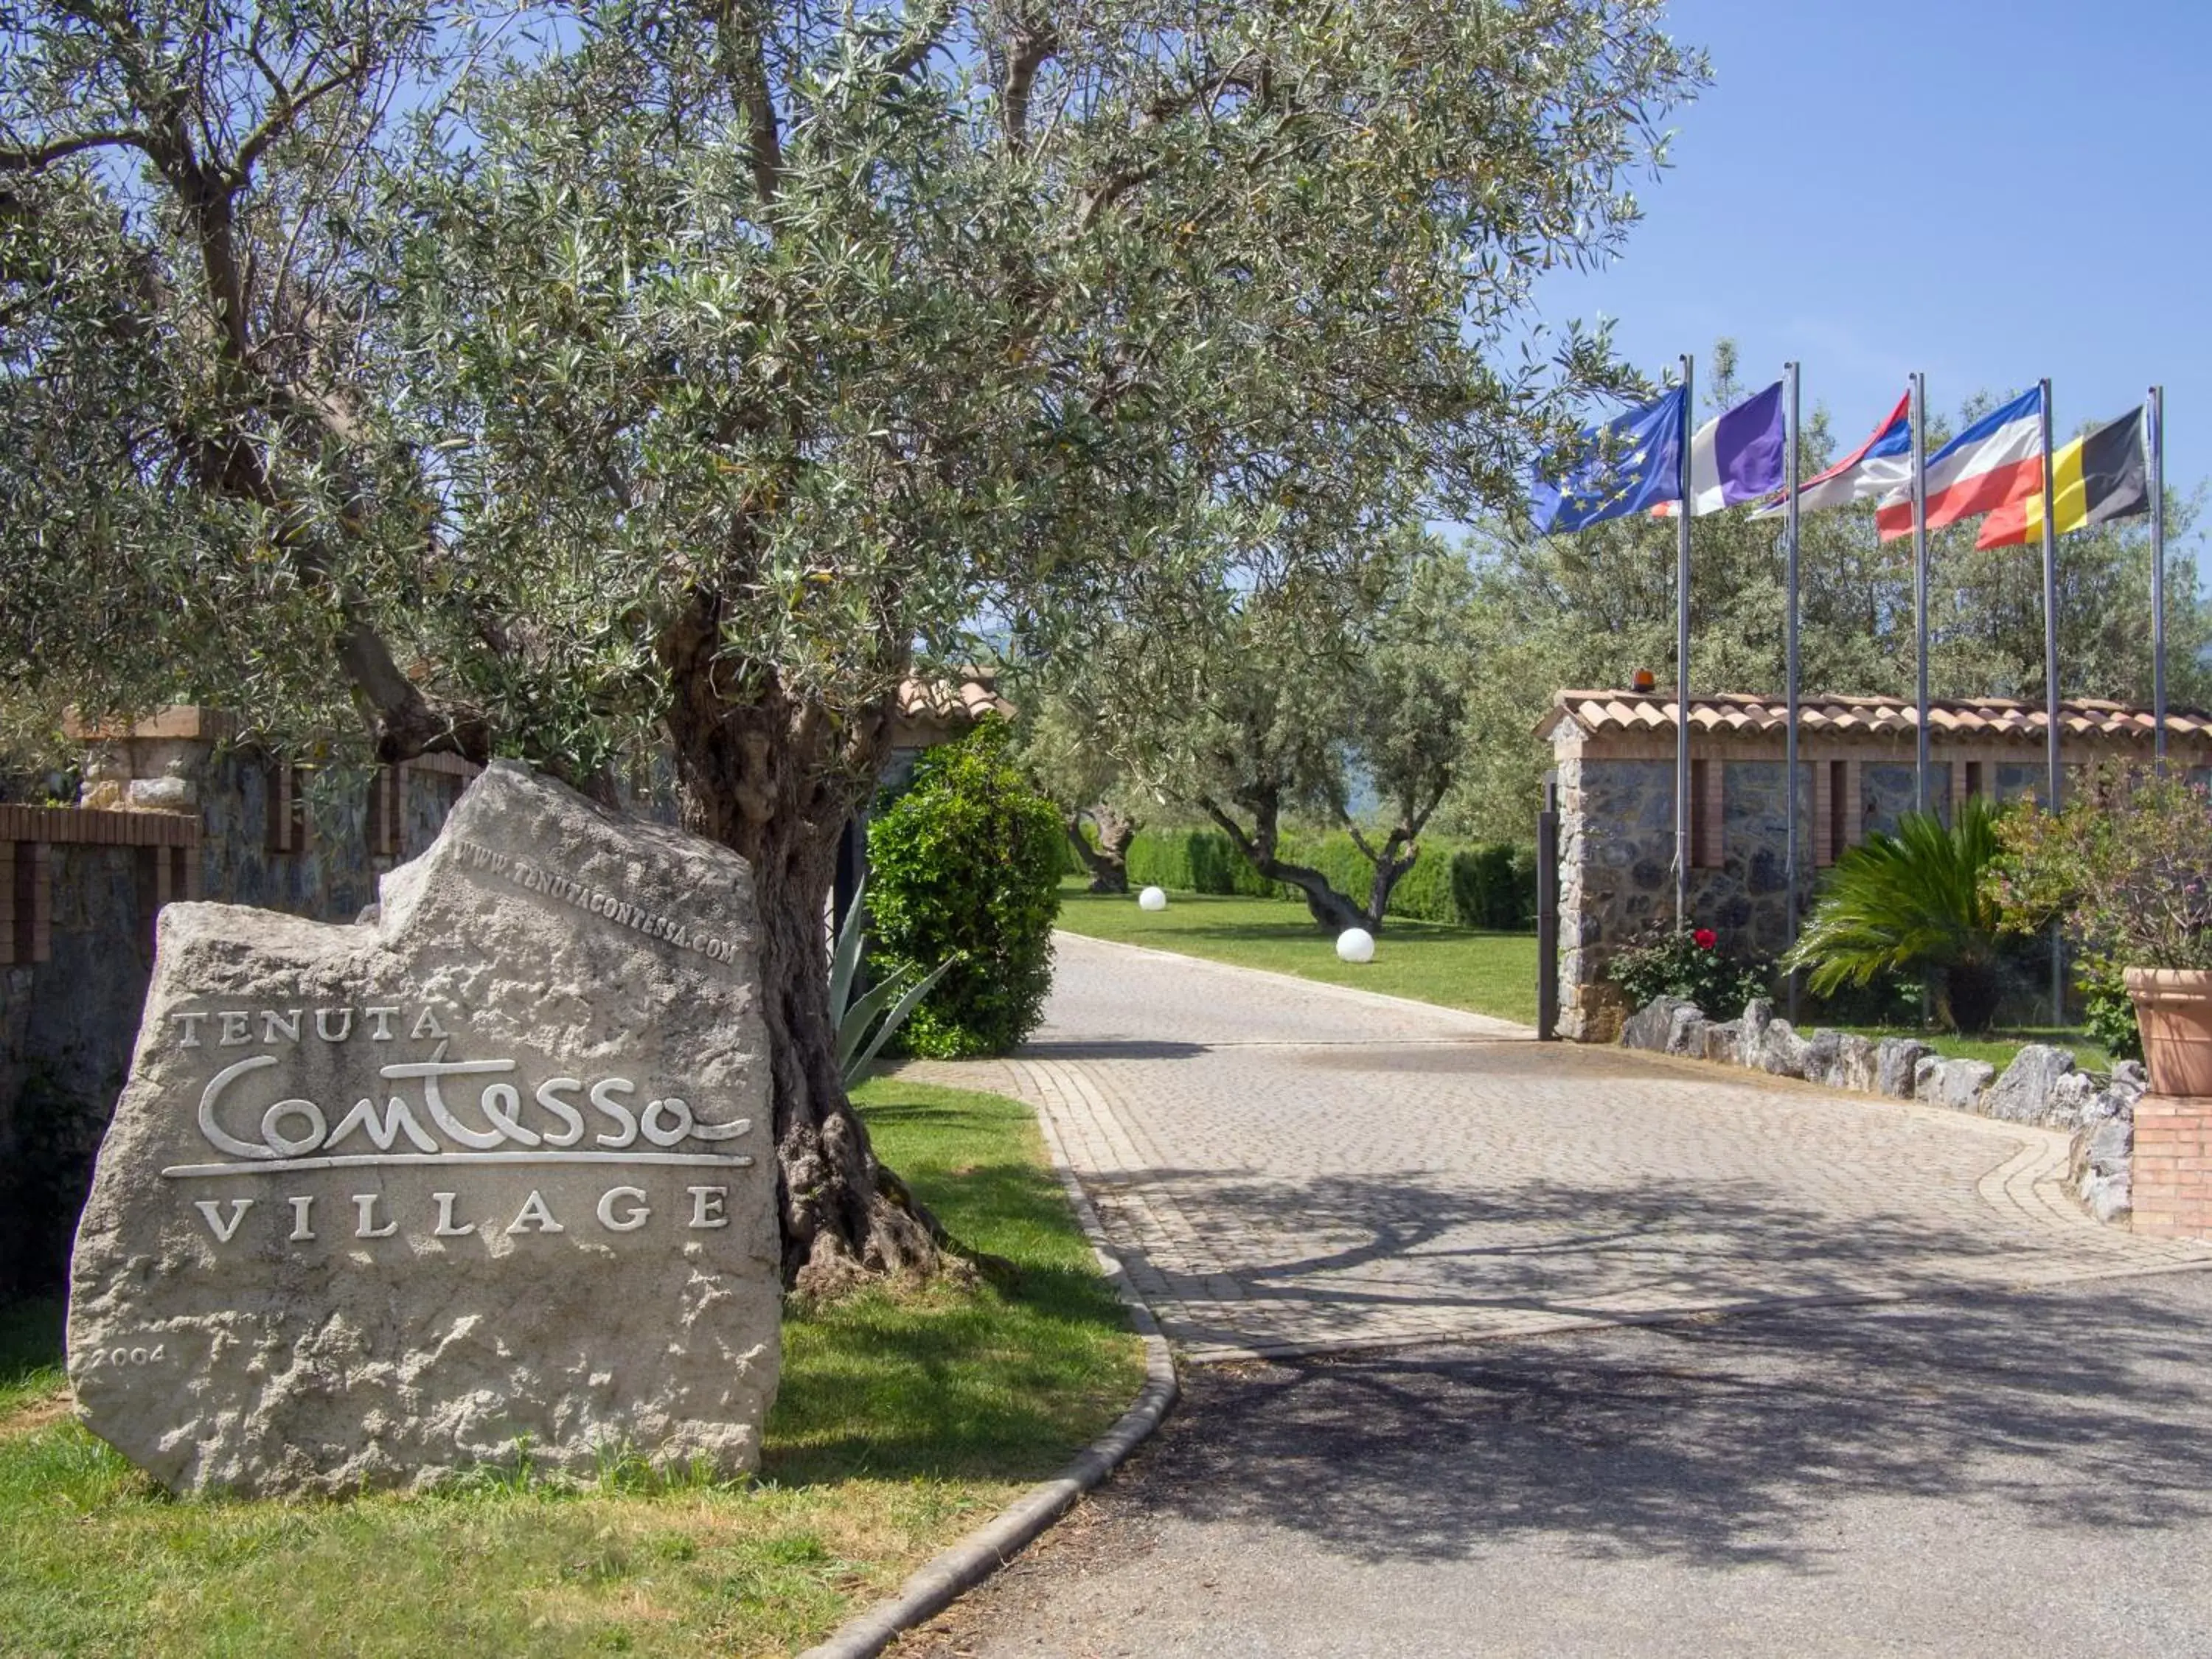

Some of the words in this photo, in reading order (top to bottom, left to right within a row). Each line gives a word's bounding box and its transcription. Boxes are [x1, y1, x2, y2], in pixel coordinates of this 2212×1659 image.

[454, 841, 739, 965] WWW.TENUTACONTESSA.COM
[171, 1006, 448, 1048] TENUTA
[195, 1186, 729, 1242] VILLAGE
[91, 1343, 165, 1369] 2004
